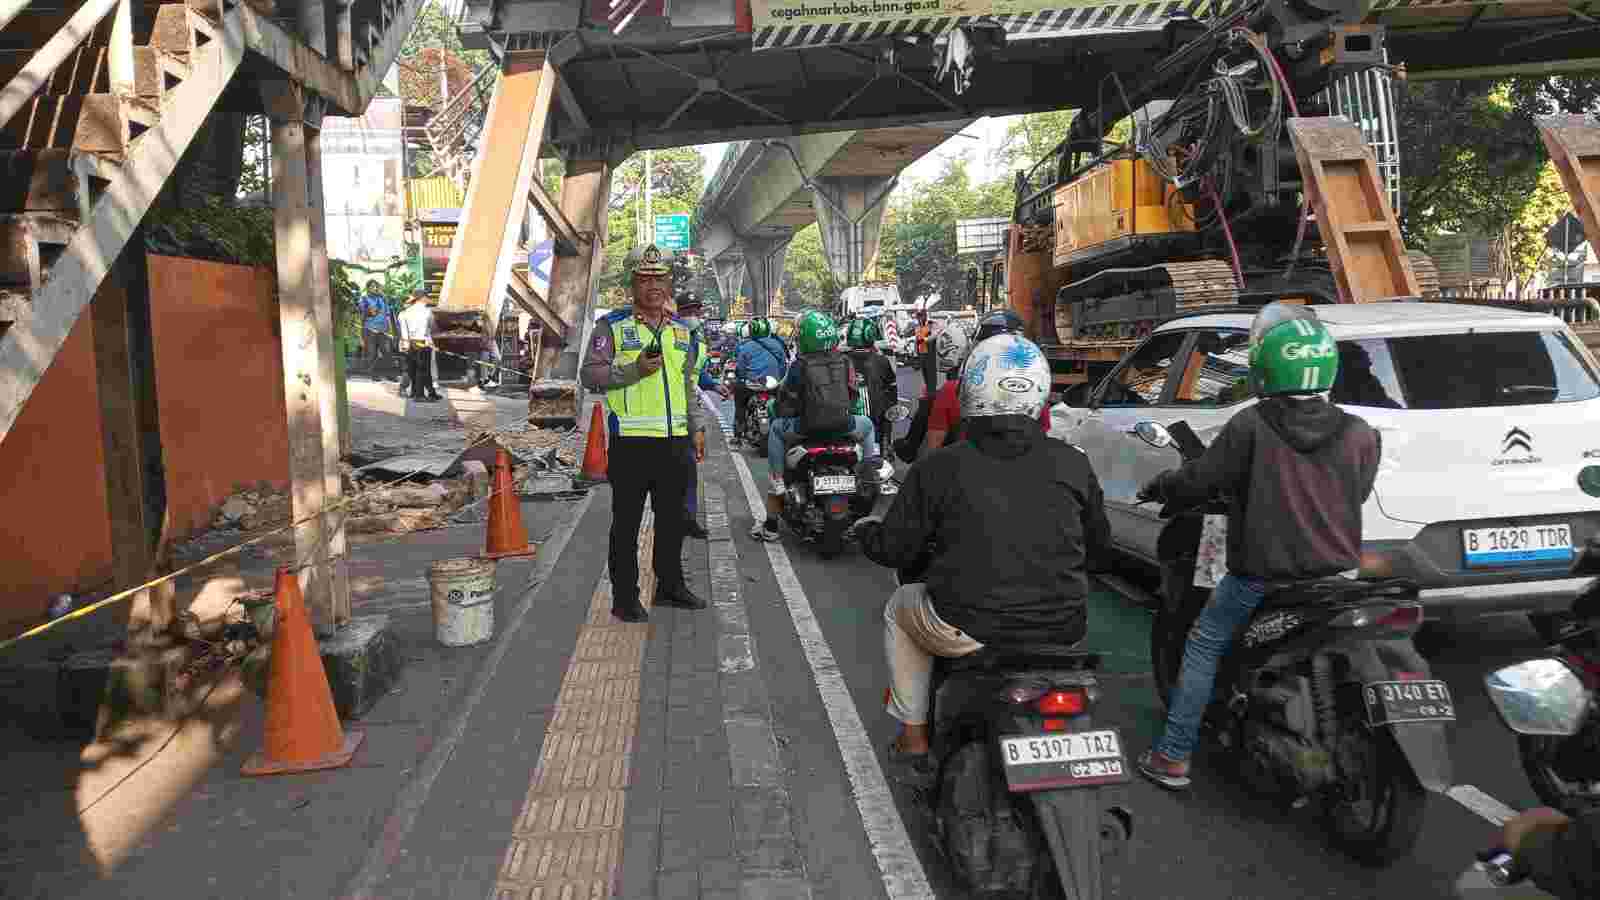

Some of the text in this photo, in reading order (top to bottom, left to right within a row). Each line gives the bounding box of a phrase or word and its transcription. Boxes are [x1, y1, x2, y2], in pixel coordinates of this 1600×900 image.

[1469, 527, 1569, 551] B 1629 TDR
[1008, 743, 1020, 761] B
[1083, 735, 1115, 753] TAZ
